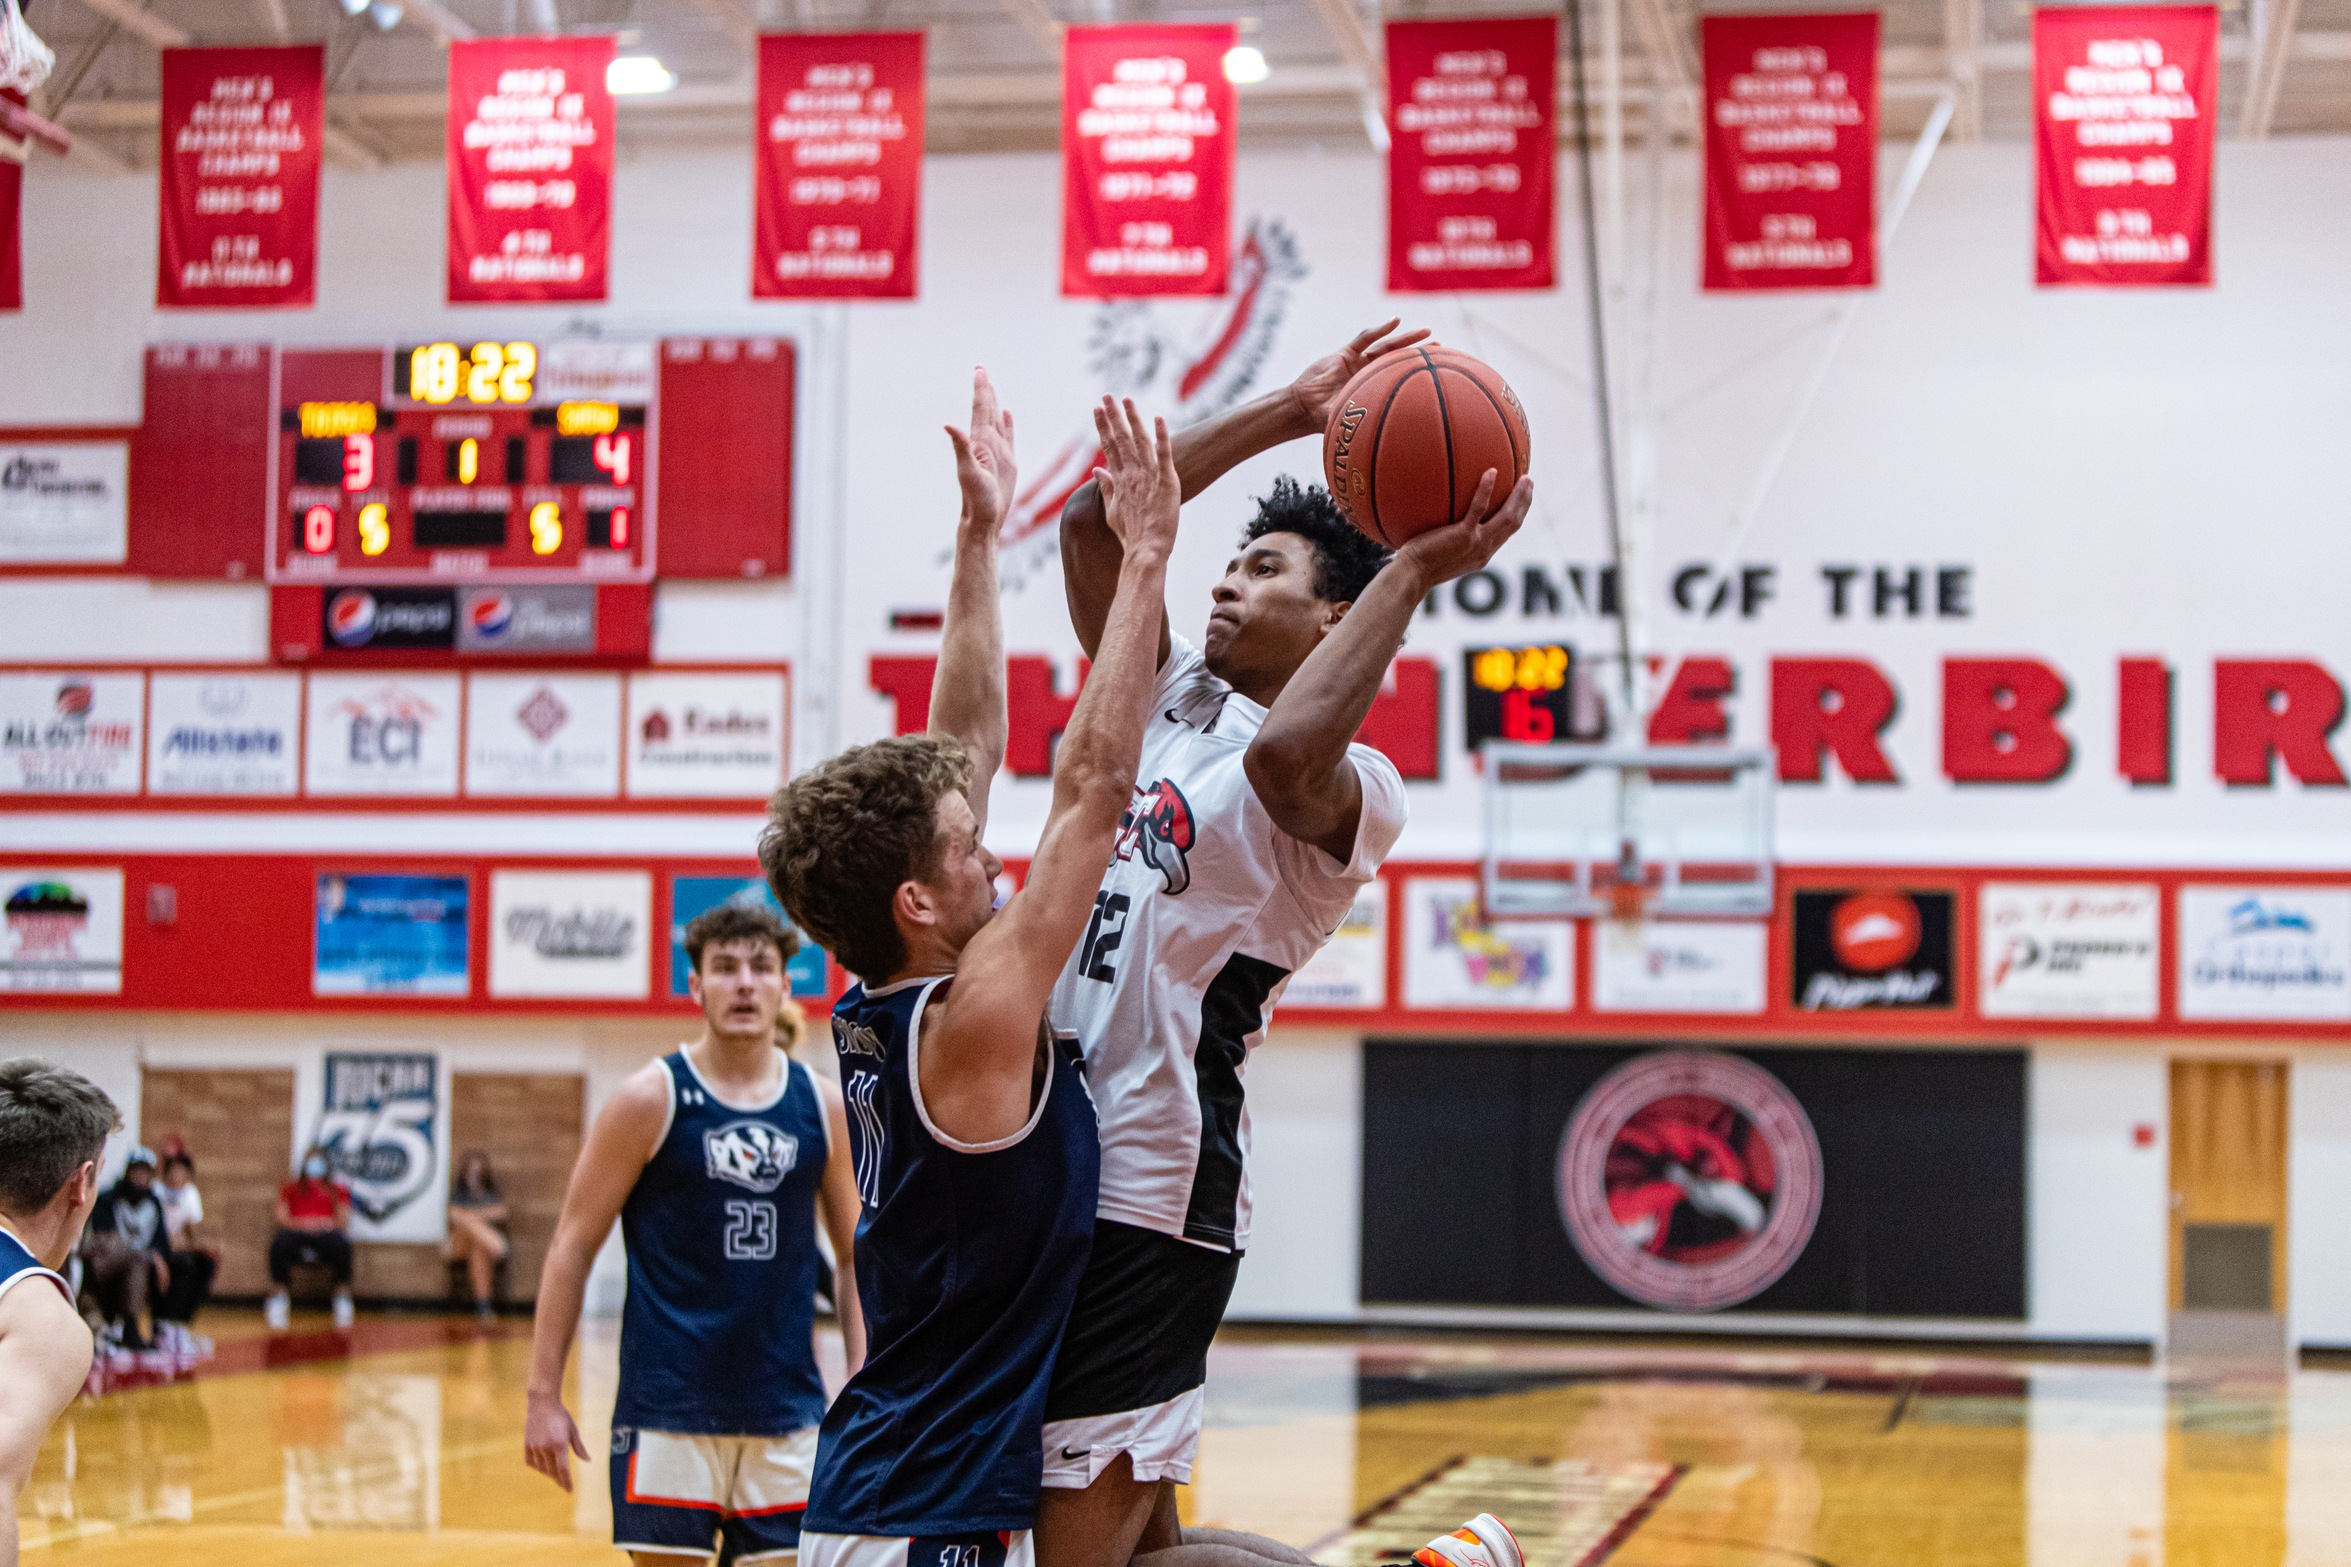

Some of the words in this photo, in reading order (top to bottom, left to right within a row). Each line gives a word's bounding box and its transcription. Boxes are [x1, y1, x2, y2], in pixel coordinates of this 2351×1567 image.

[342, 433, 375, 492] 3
[459, 437, 478, 484] 1
[594, 431, 631, 486] 4
[304, 504, 335, 555] 0
[610, 505, 629, 550] 1
[1672, 564, 1776, 618] OF
[1821, 565, 1973, 618] THE
[1078, 889, 1131, 985] 12
[723, 1201, 778, 1260] 23
